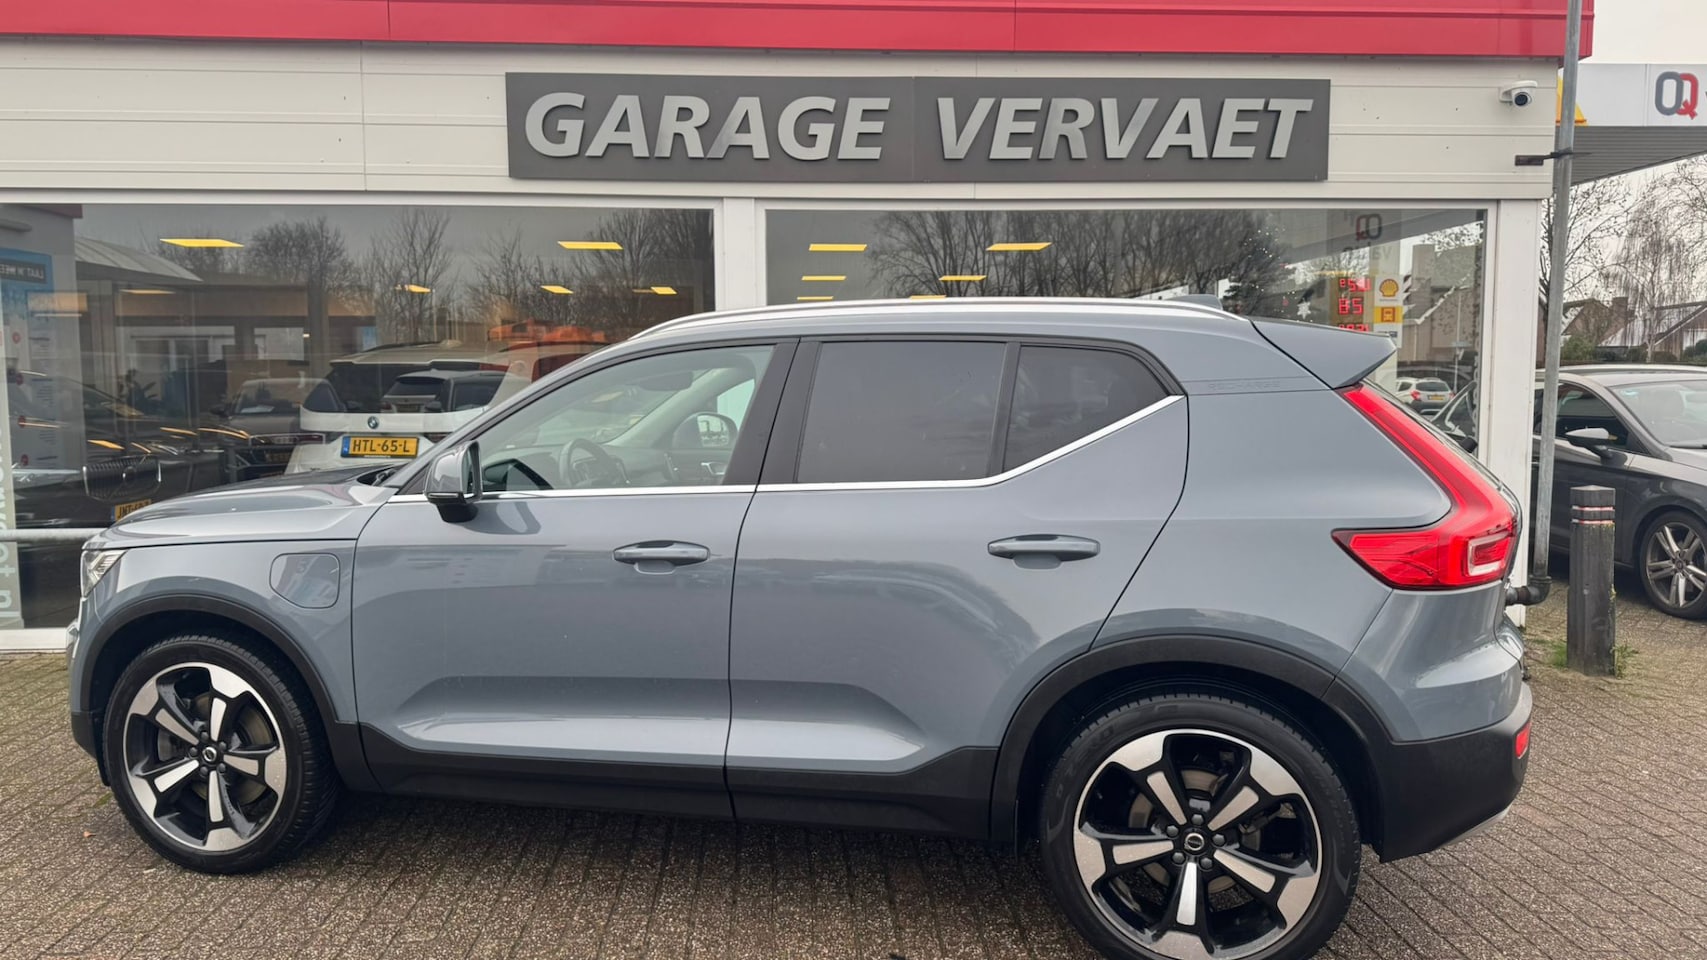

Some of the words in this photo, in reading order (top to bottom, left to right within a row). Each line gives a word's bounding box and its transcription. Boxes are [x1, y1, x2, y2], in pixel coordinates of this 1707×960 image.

[524, 92, 891, 161] GARAGE
[937, 97, 1313, 160] VERVAET
[352, 439, 411, 453] HTL-65-L
